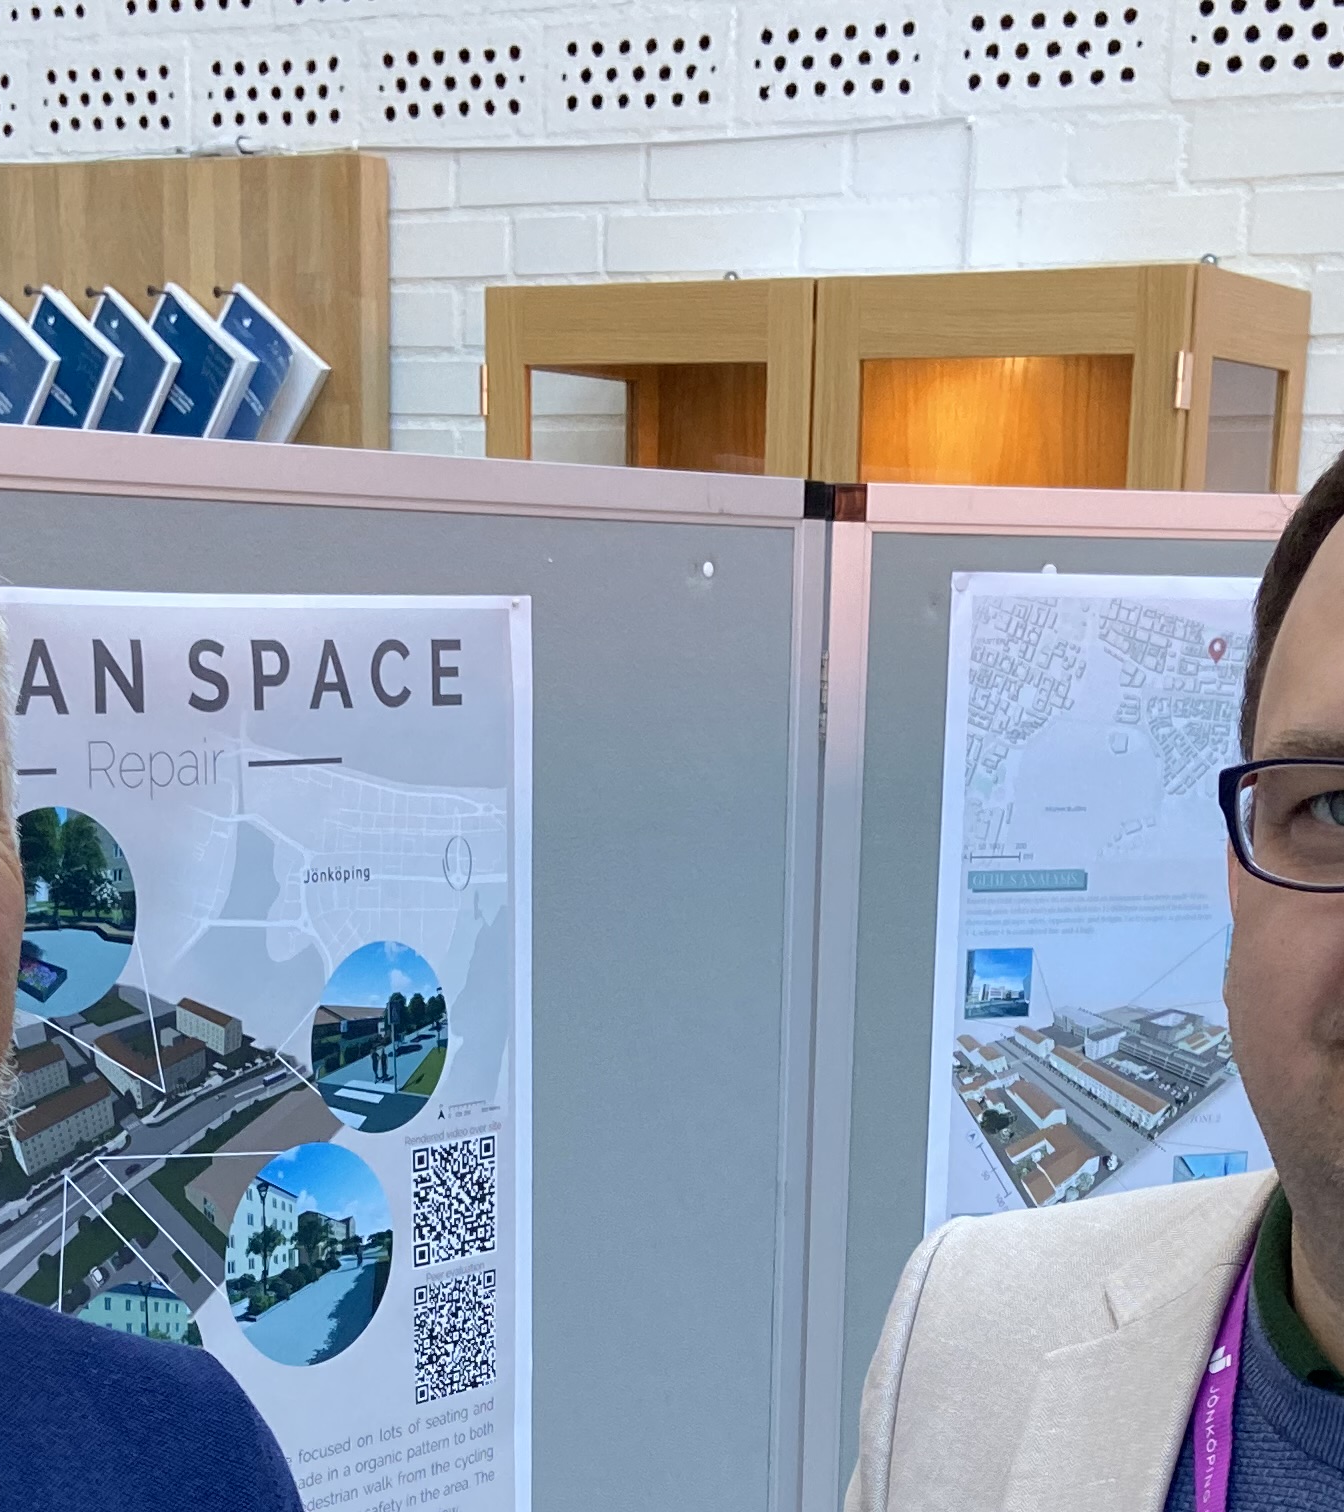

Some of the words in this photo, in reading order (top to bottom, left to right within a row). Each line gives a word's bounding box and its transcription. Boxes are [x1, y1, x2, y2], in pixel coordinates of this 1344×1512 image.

[187, 637, 465, 715] SPACE
[86, 737, 226, 801] Repair
[302, 863, 373, 886] Jönköping
[446, 1127, 468, 1140] video
[470, 1123, 487, 1134] over
[296, 1471, 324, 1491] ade
[327, 1466, 339, 1482] in
[343, 1465, 352, 1478] a
[355, 1449, 404, 1474] organic
[406, 1437, 451, 1464] pattern
[453, 1430, 467, 1446] to
[469, 1420, 495, 1441] both
[297, 1436, 352, 1465] focused
[356, 1433, 375, 1449] on
[379, 1425, 404, 1443] lots
[408, 1417, 422, 1436] of
[425, 1407, 470, 1431] seating
[473, 1396, 495, 1417] and
[1201, 1385, 1220, 1505] JÖNKÖPING
[362, 1475, 394, 1497] walk
[398, 1467, 428, 1487] from
[431, 1460, 451, 1477] the
[454, 1446, 495, 1472] cycling
[406, 1493, 418, 1508] in
[420, 1487, 441, 1504] the
[474, 1469, 496, 1487] The
